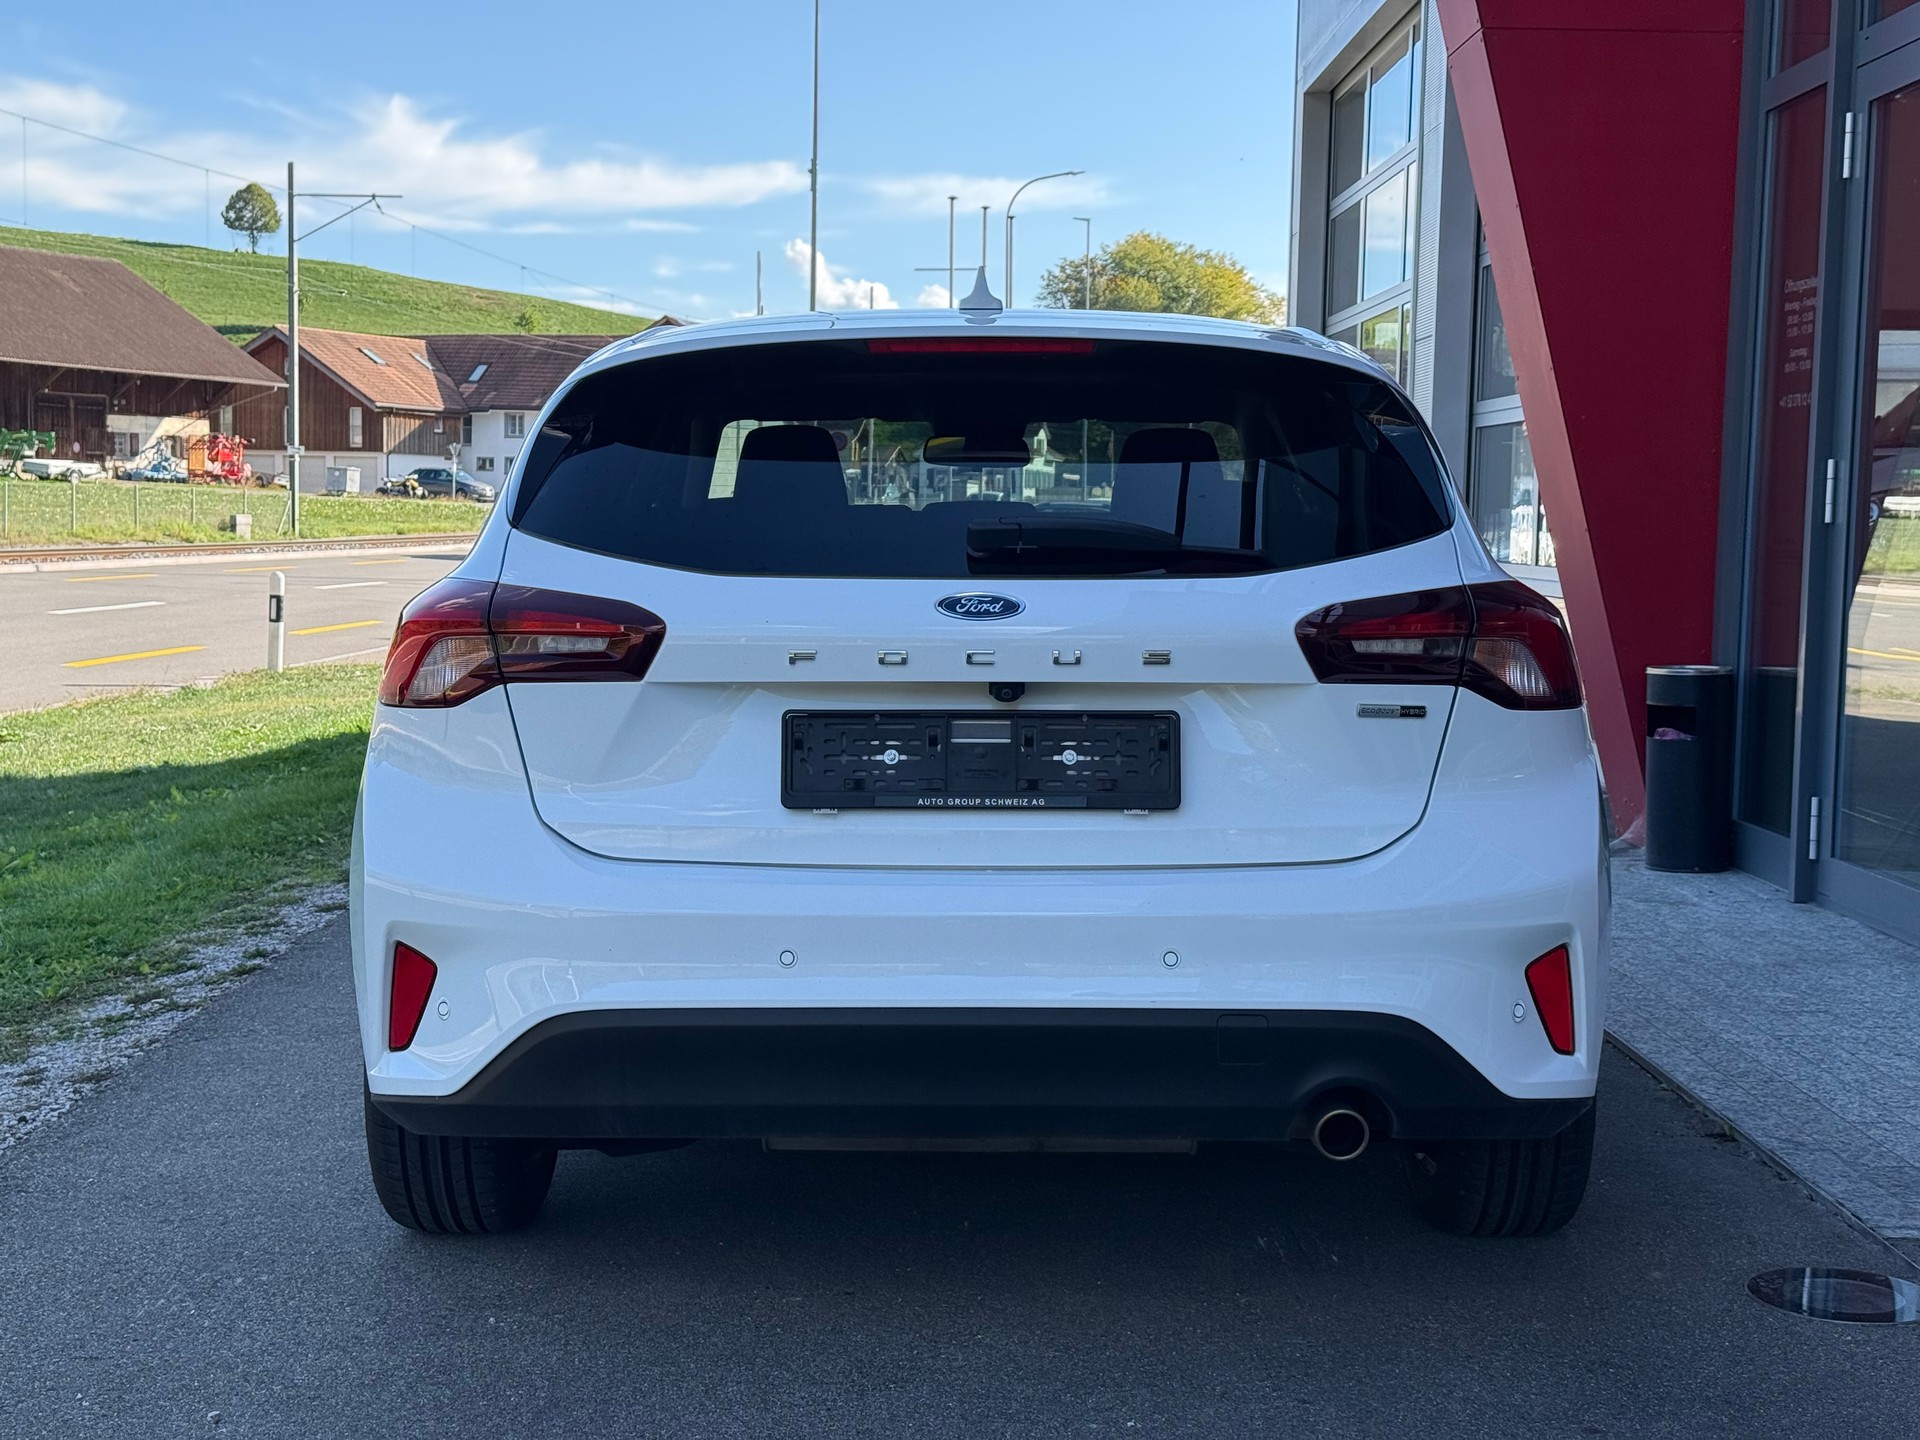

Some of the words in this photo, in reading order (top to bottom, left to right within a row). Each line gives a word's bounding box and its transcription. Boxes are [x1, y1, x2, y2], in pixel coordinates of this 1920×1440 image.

[956, 597, 1004, 613] Ford
[788, 650, 1171, 665] FOCUS
[1400, 708, 1426, 716] HYBRID
[917, 798, 944, 806] AUTO
[947, 798, 981, 806] GROUP
[984, 798, 1028, 806] SCHWEIZ
[1031, 798, 1046, 806] AG
